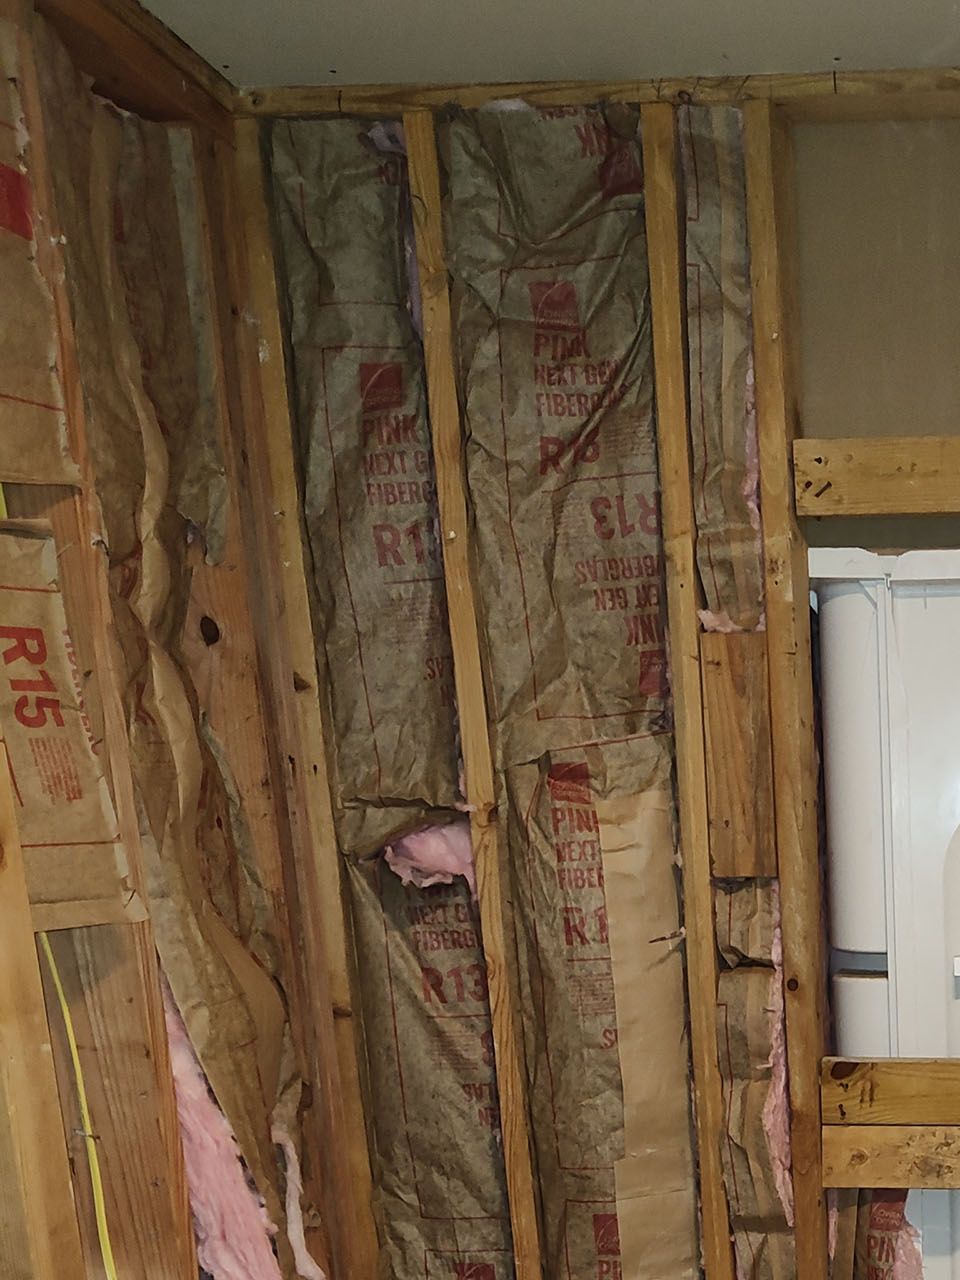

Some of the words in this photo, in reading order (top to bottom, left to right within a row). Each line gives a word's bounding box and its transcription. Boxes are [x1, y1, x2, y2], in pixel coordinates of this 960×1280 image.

[534, 363, 577, 386] NEXT
[362, 412, 420, 448] PINK
[364, 450, 407, 476] NEXT
[590, 491, 660, 541] R13
[592, 586, 628, 612] GEN
[635, 583, 660, 609] EXT
[0, 625, 65, 728] R15
[555, 840, 600, 863] NEXT
[422, 962, 489, 1005] R13
